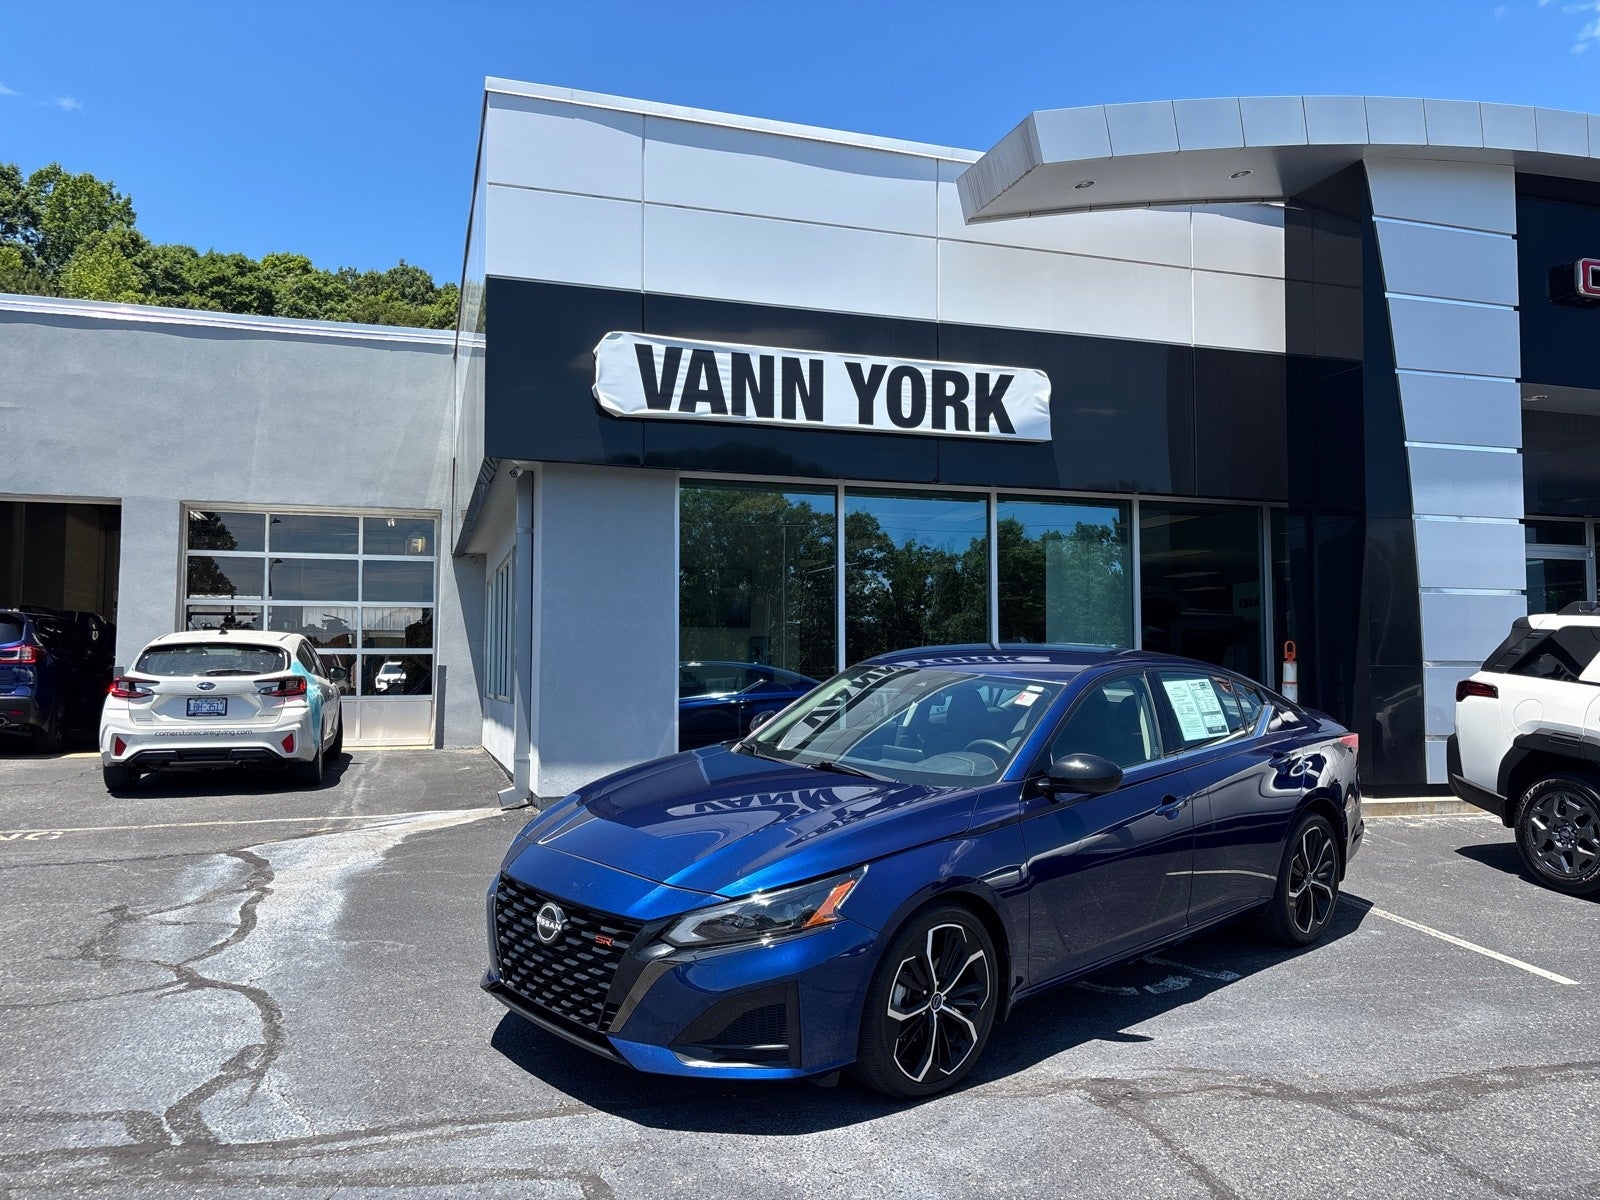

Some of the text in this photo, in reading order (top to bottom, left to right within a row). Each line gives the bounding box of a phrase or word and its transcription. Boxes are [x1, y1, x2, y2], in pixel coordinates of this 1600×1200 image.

[634, 343, 1016, 435] VANN YORK
[154, 729, 253, 738] cornerstonecaregiving.com
[536, 914, 562, 931] NISSAN
[595, 933, 615, 947] SR
